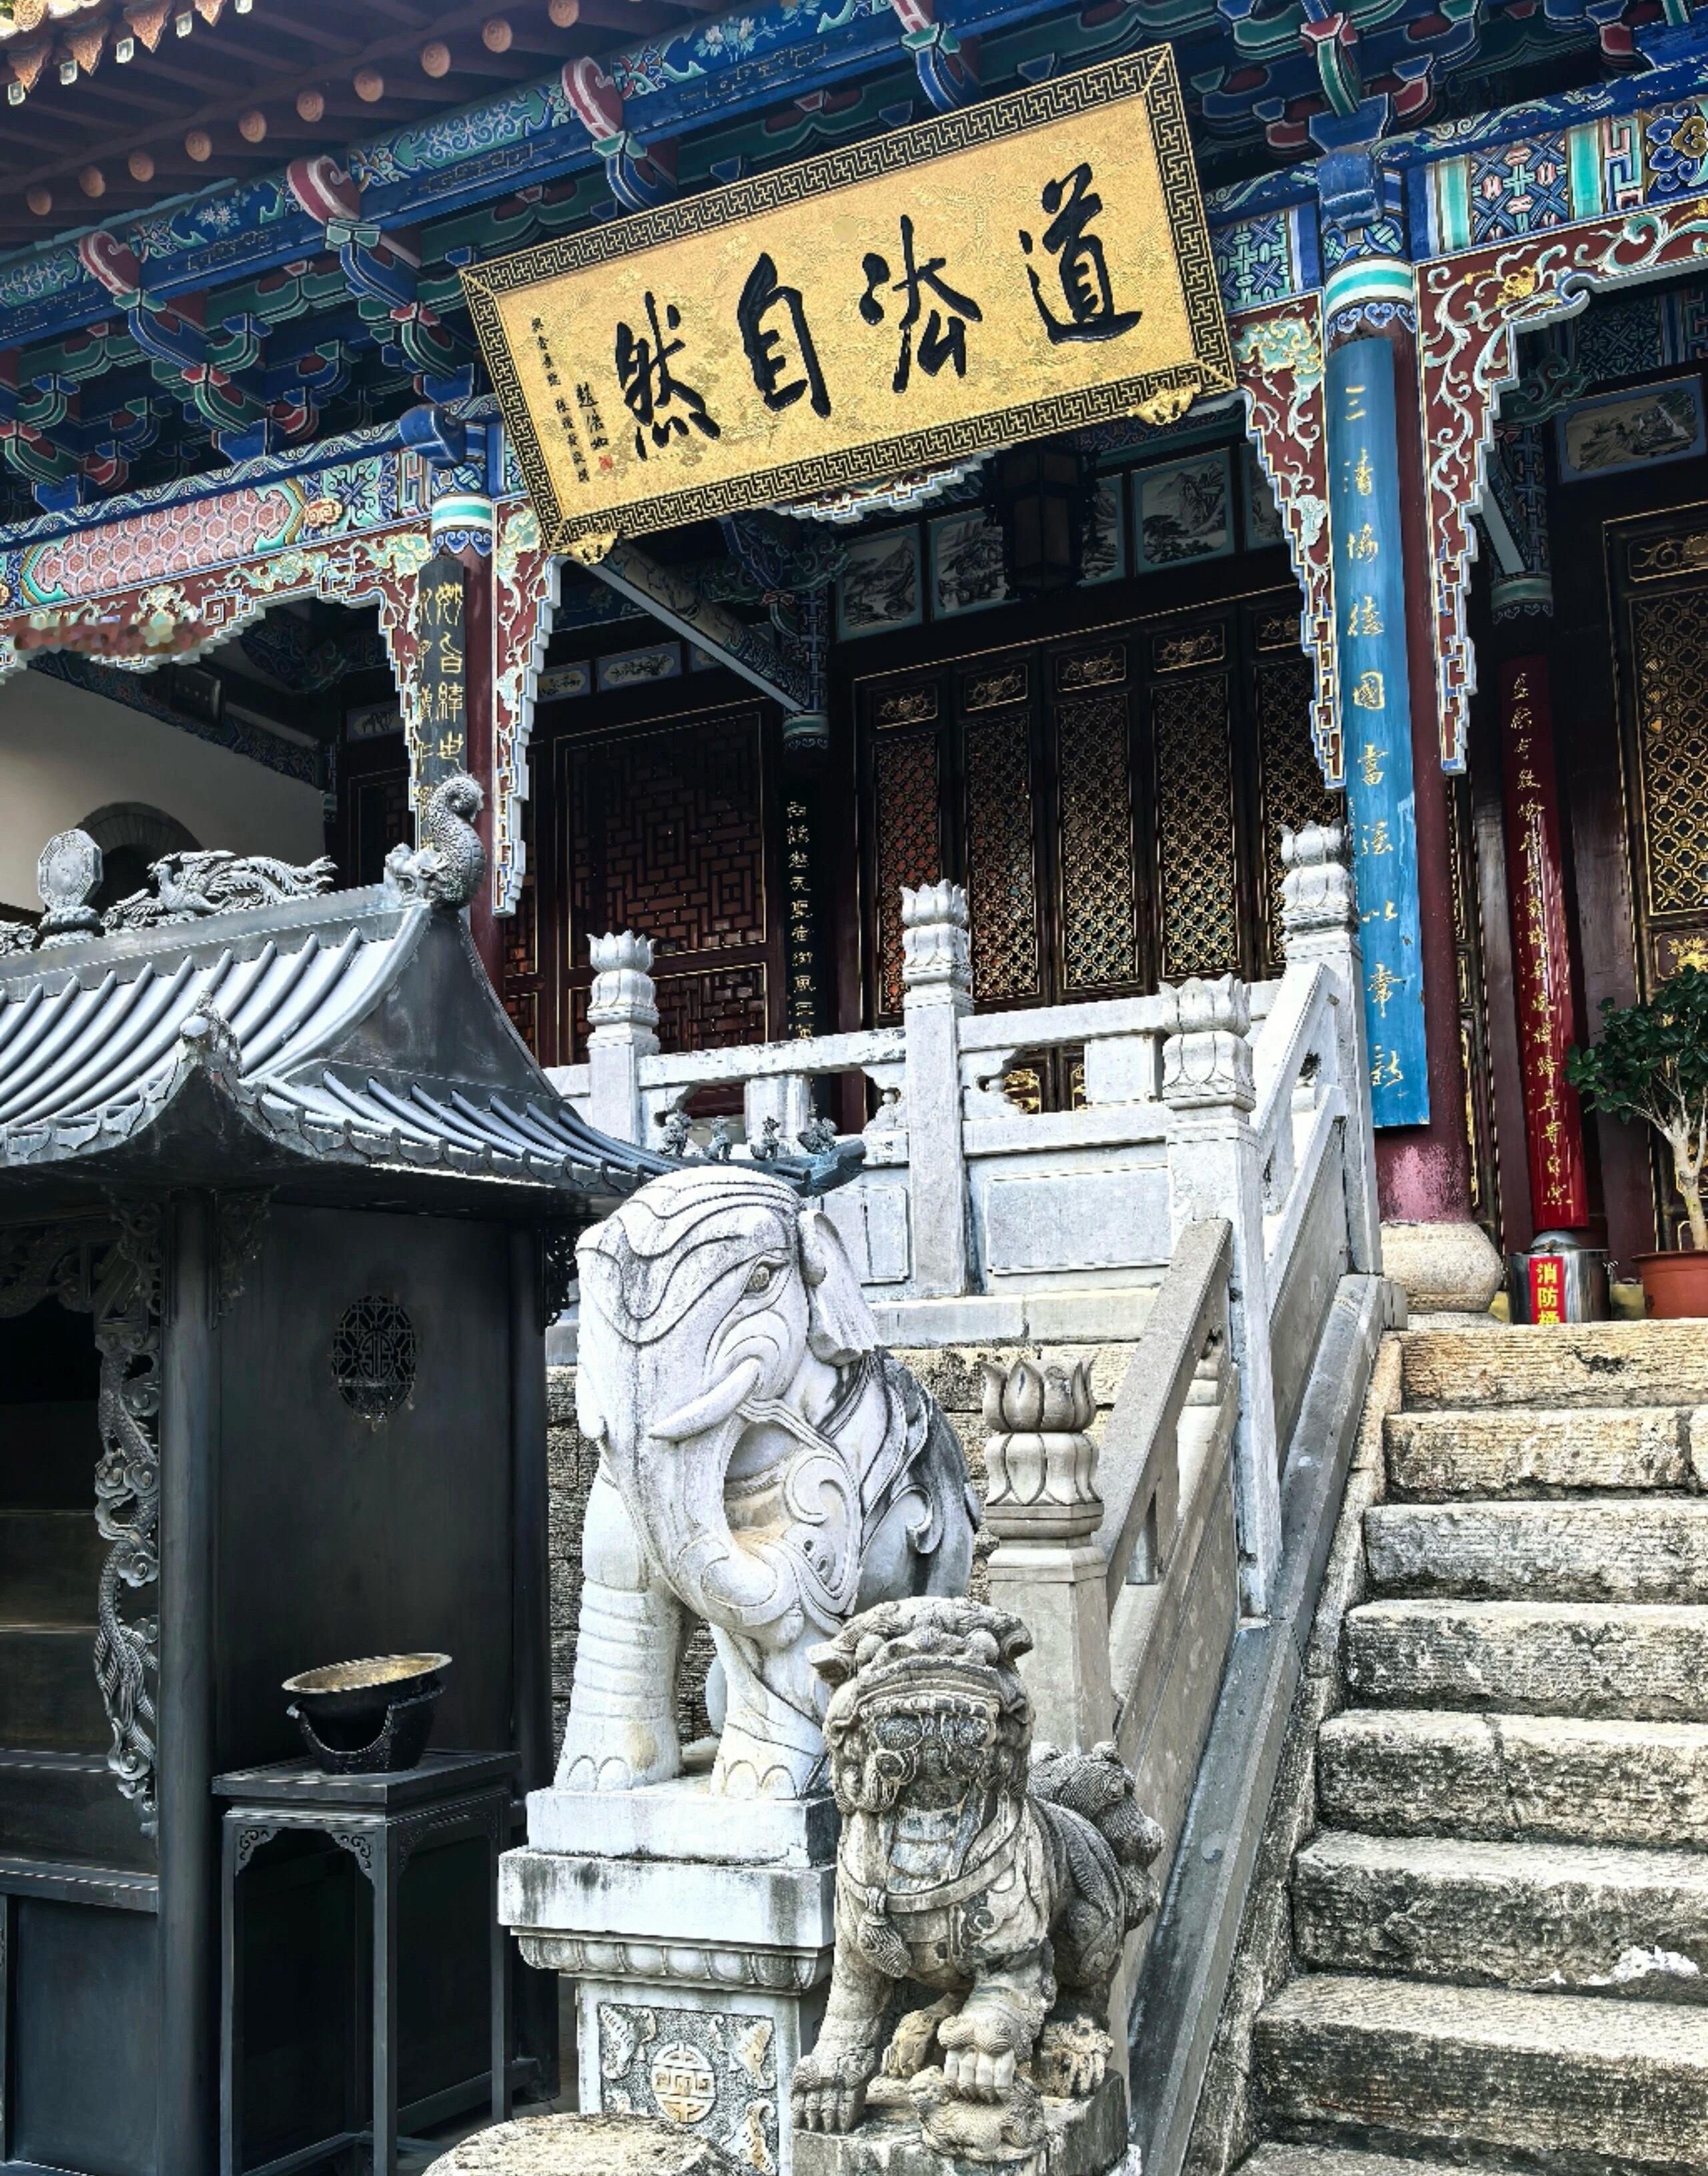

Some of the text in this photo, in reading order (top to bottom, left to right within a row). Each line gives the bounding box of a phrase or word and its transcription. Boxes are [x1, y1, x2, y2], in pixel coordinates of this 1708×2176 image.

[614, 162, 1144, 460] 道法自然
[1536, 1262, 1560, 1325] 消防桶
